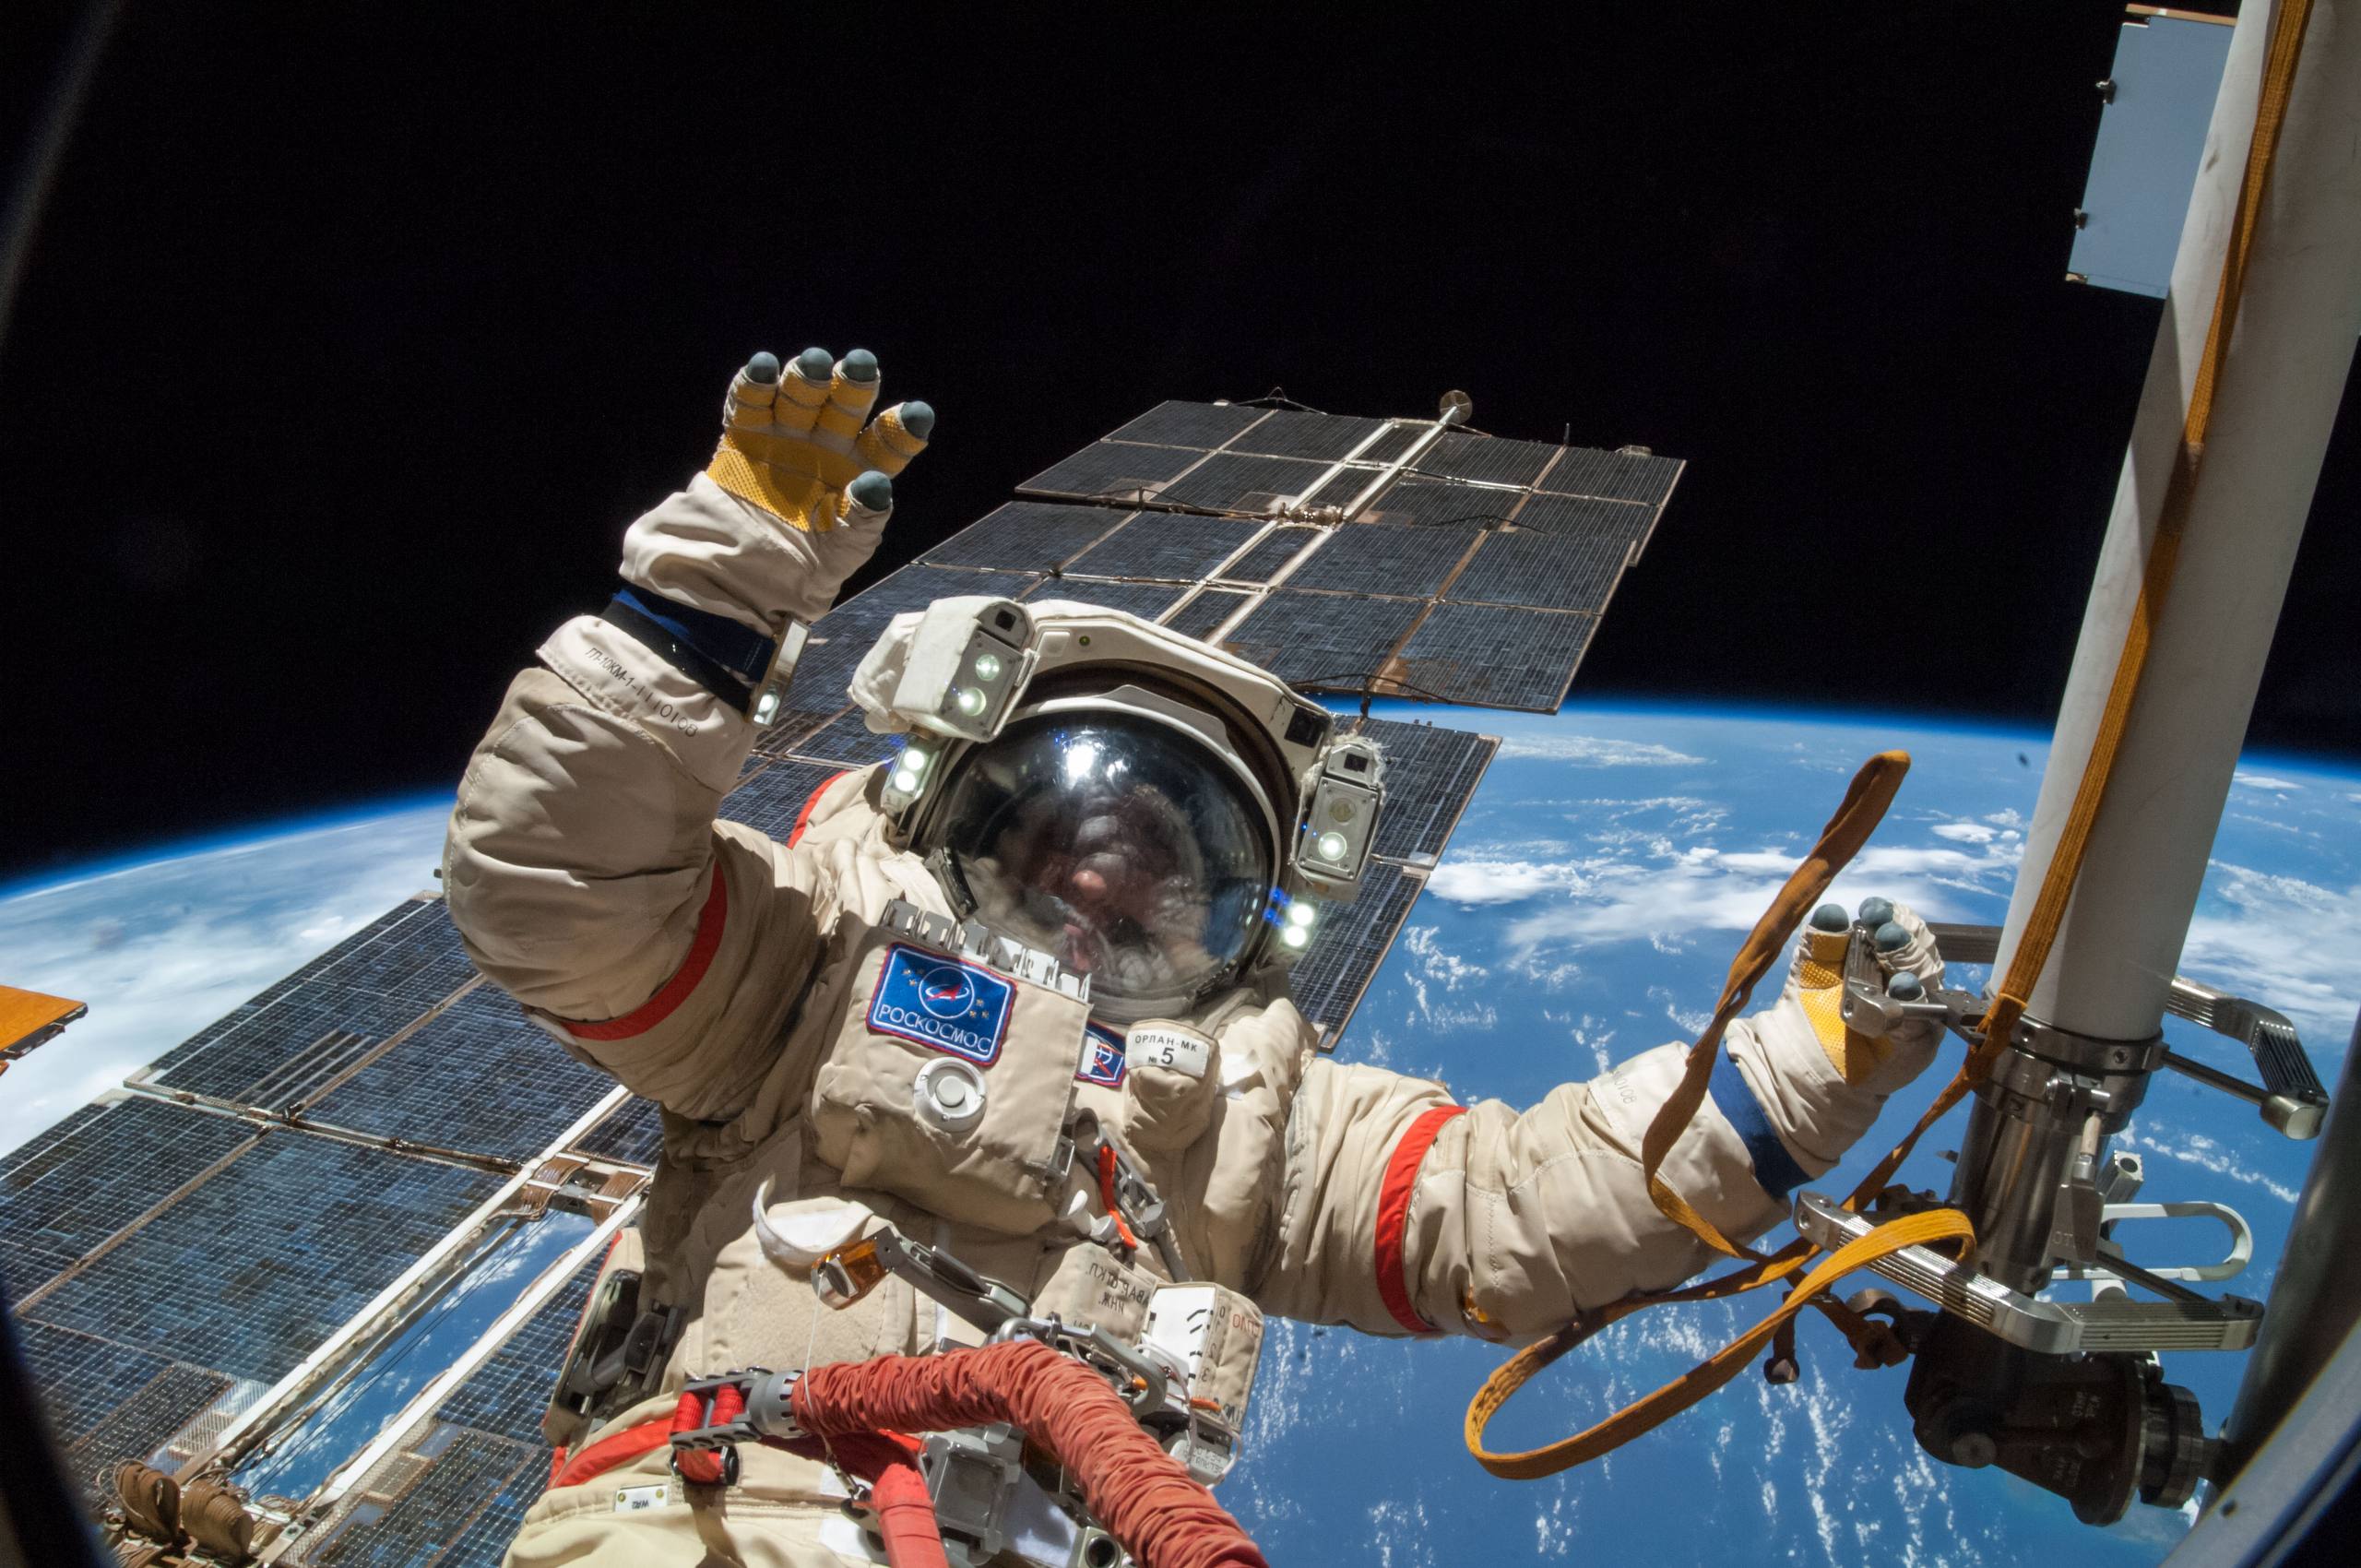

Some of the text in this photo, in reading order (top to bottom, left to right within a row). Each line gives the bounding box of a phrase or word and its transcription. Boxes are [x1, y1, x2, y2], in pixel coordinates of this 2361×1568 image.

[878, 1003, 992, 1052] РОСКОСМОС
[1134, 1034, 1198, 1052] ОРЛАН-МК
[1160, 1047, 1175, 1065] 5
